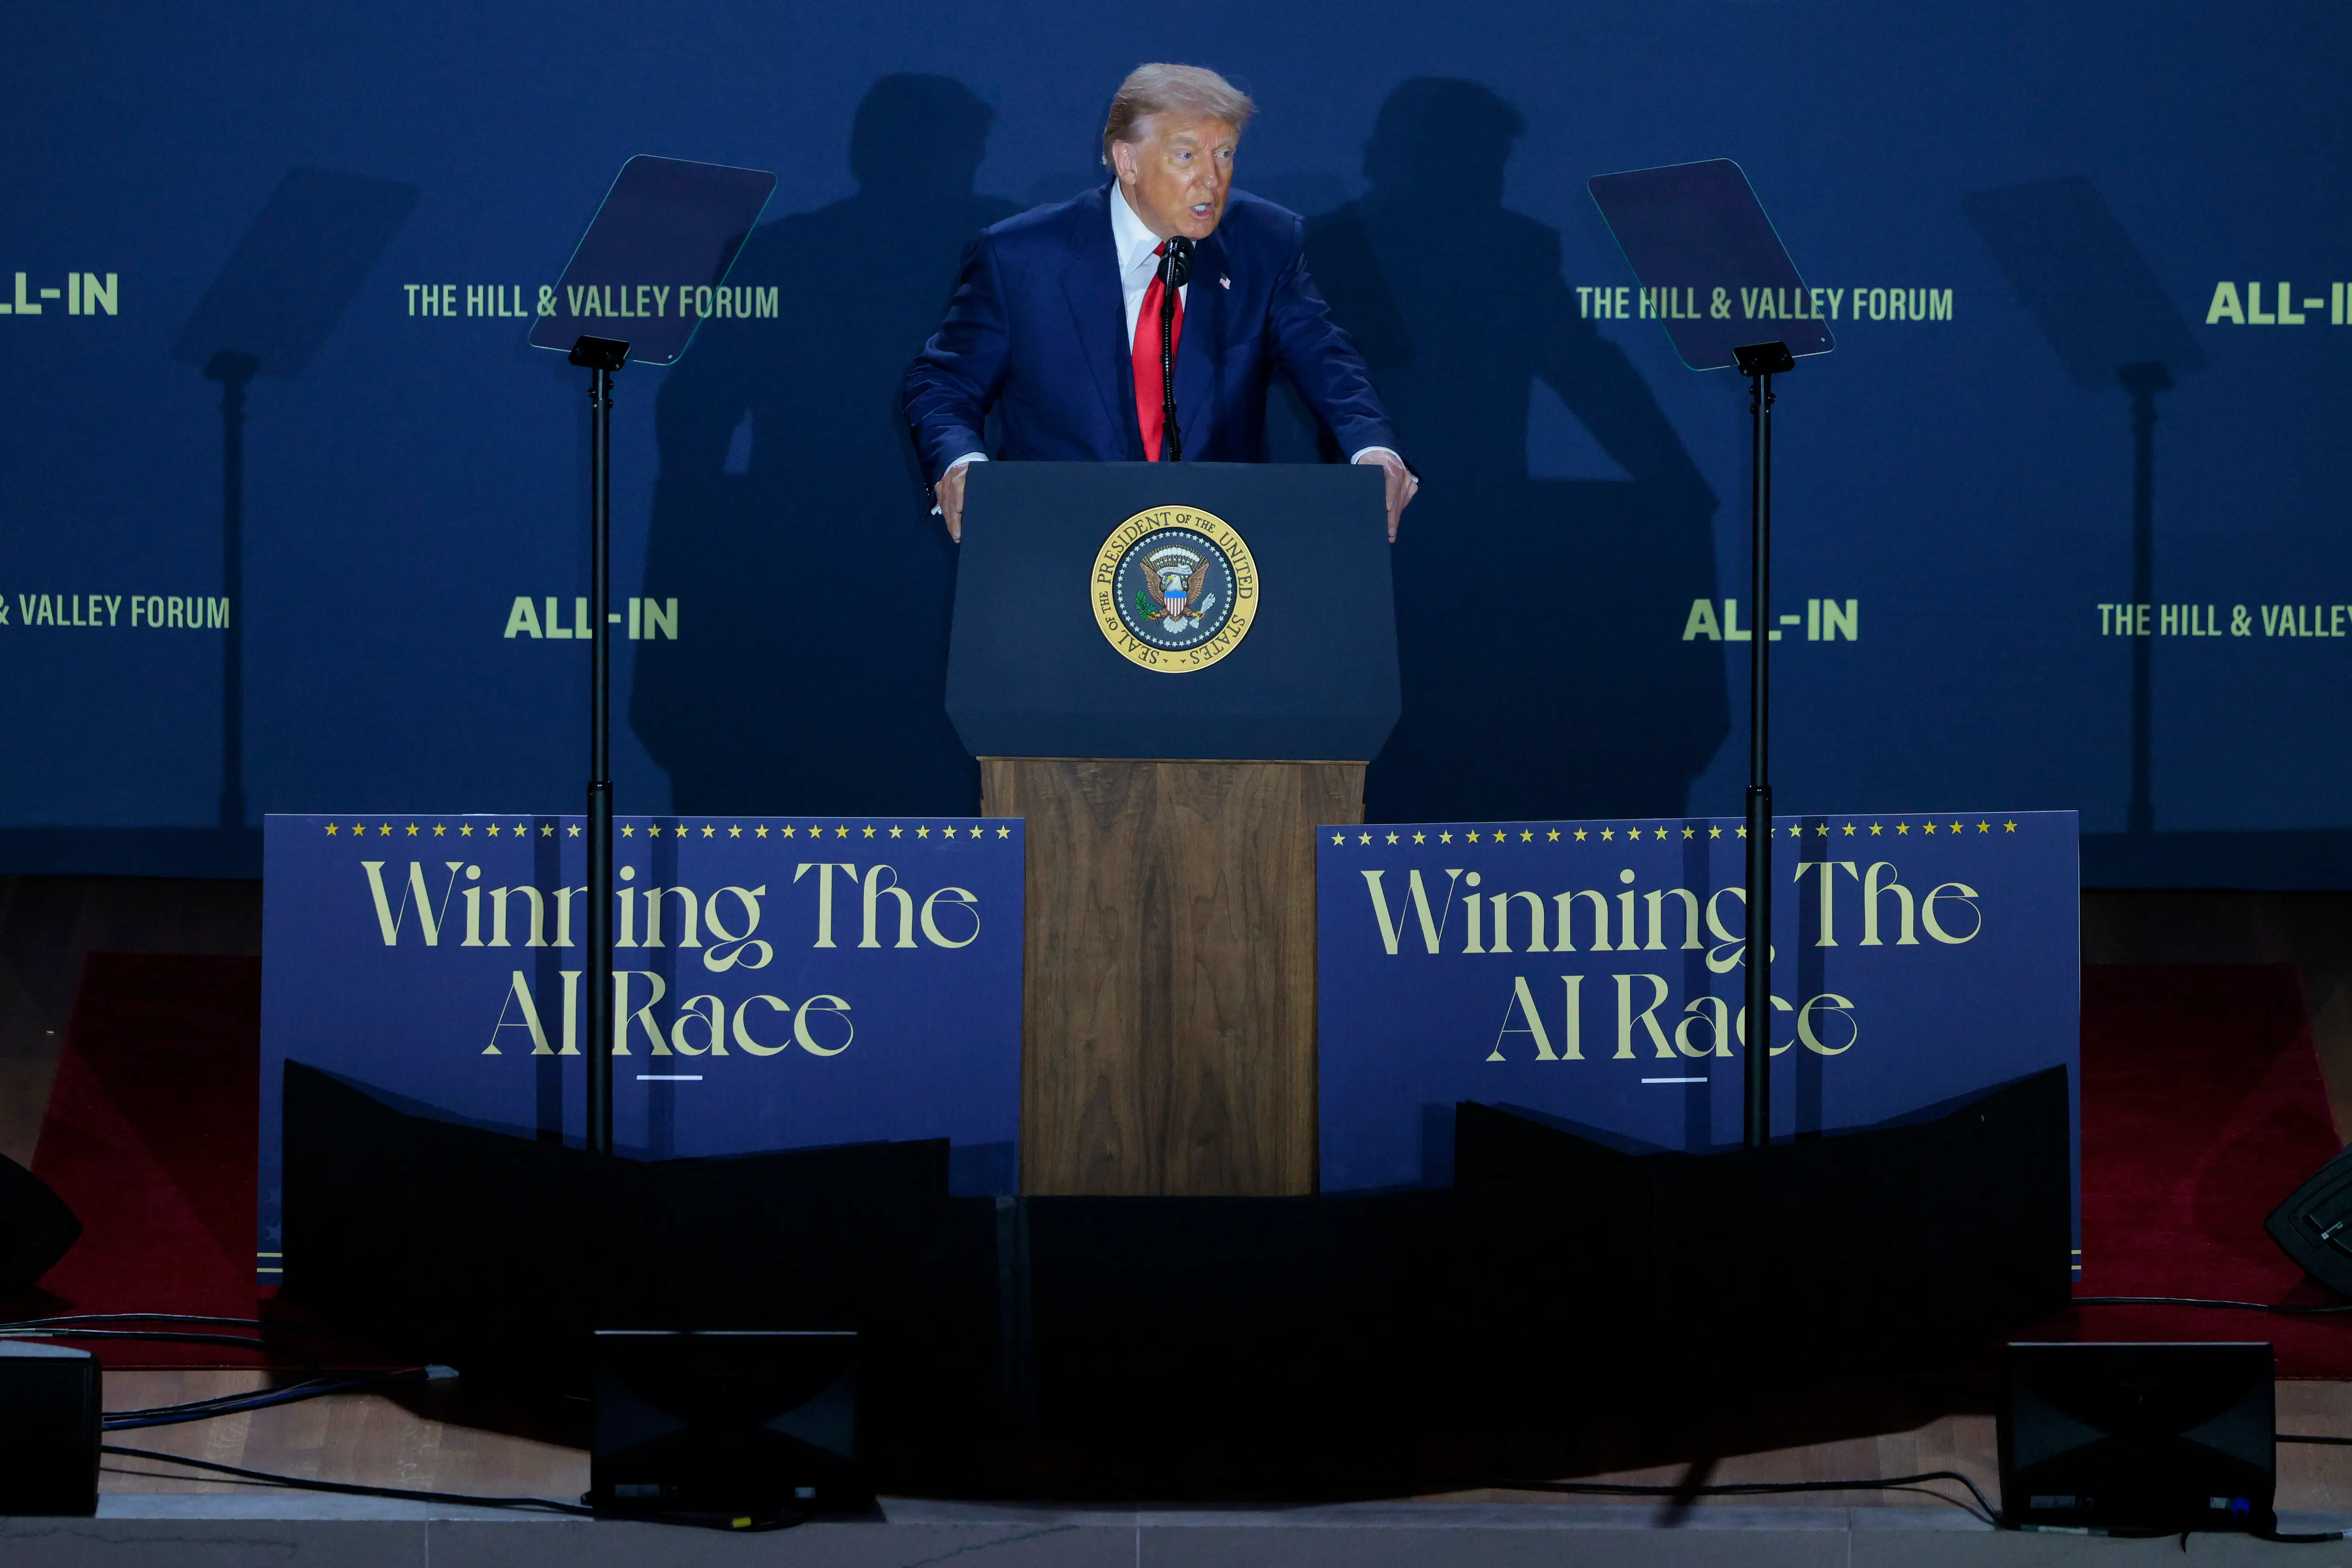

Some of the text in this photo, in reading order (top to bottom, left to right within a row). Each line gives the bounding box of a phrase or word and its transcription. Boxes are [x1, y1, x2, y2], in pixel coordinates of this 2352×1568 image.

[404, 284, 779, 318] THE HILL & VALLEY FORUM
[1576, 286, 1953, 321] THE HILL & VALLEY FORUM
[2205, 281, 2352, 325] ALL-I
[19, 593, 122, 626] VALLEY
[131, 595, 229, 628] FORUM
[1097, 512, 1253, 665] SEAL OF THE PRESIDENT OF THE UNITED STATES
[504, 596, 678, 641] ALL-IN
[1682, 598, 1858, 641] AL-IN
[2097, 603, 2151, 635] THE
[2160, 604, 2222, 636] HILL
[2230, 604, 2252, 636] &
[793, 863, 981, 949] The
[1794, 861, 1982, 946] The
[481, 970, 854, 1057] AI Race
[1485, 975, 1585, 1061] AI
